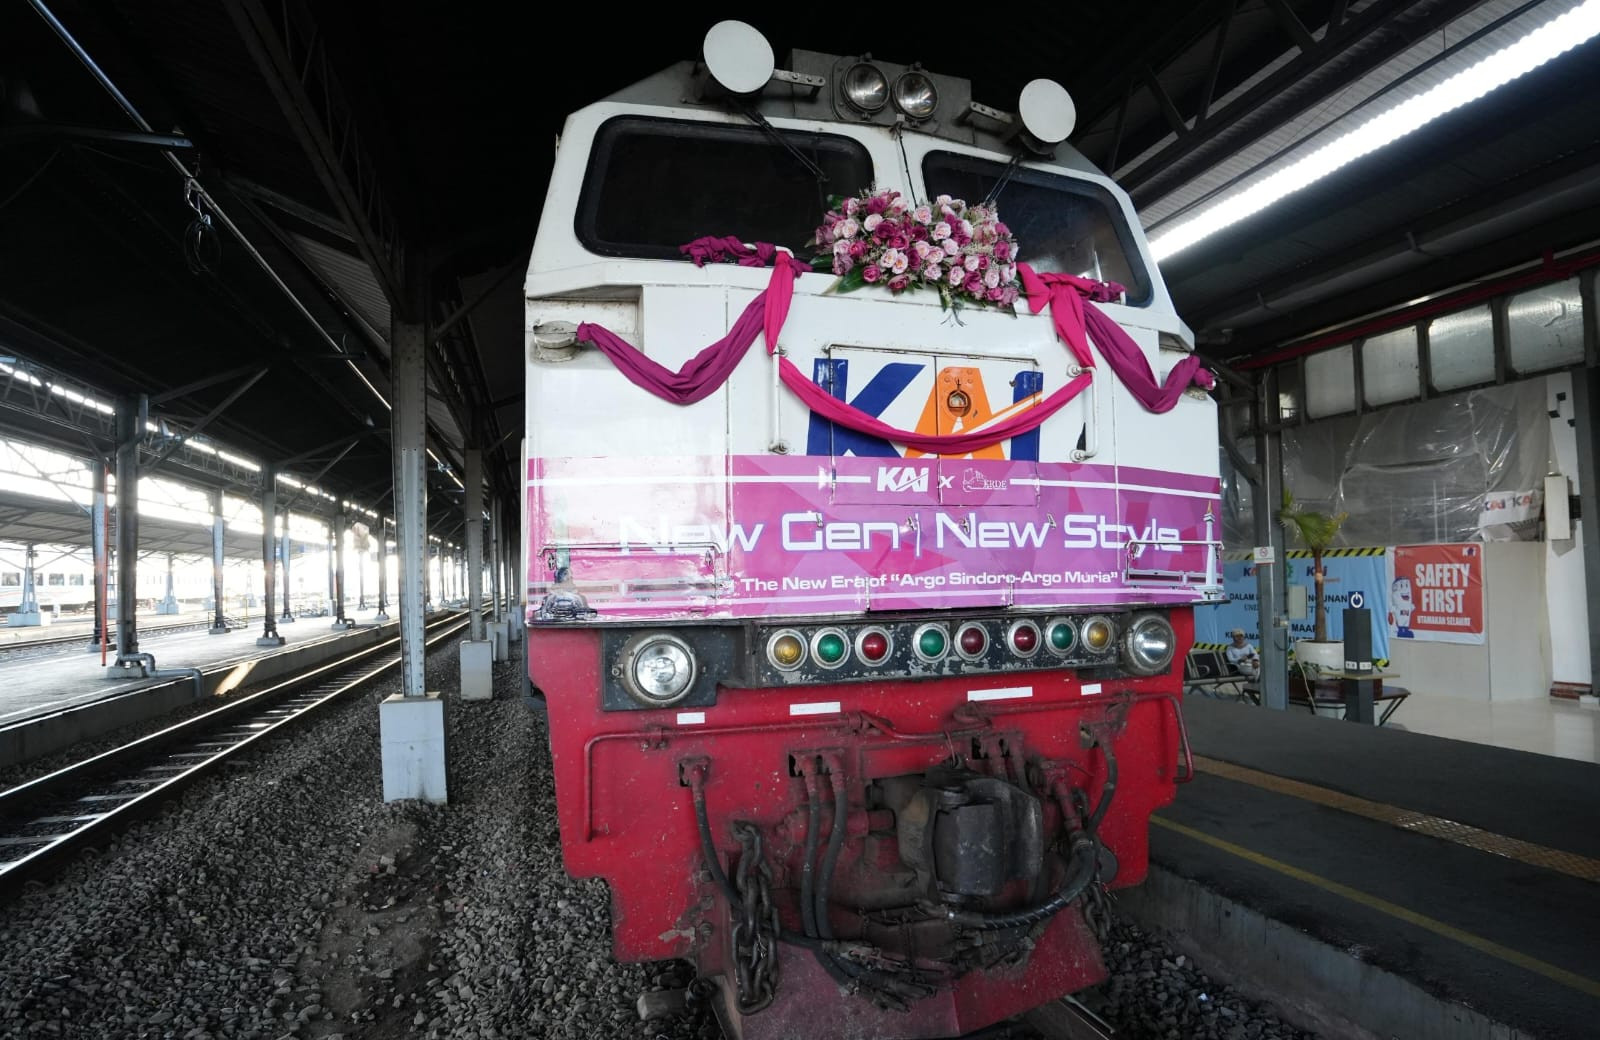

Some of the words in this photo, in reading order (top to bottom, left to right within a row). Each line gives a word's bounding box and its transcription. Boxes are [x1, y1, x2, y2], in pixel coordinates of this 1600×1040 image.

[806, 358, 1044, 462] KAI
[877, 467, 929, 492] KAI
[619, 514, 764, 556] New
[782, 511, 899, 551] Gen
[935, 512, 1049, 549] New
[1064, 514, 1183, 558] Style
[740, 577, 779, 592] The
[782, 577, 827, 591] New
[831, 575, 865, 589] Era
[869, 574, 888, 588] of
[1415, 563, 1470, 588] SAFETY
[1229, 593, 1255, 601] DALAM
[1421, 588, 1465, 613] FIRST
